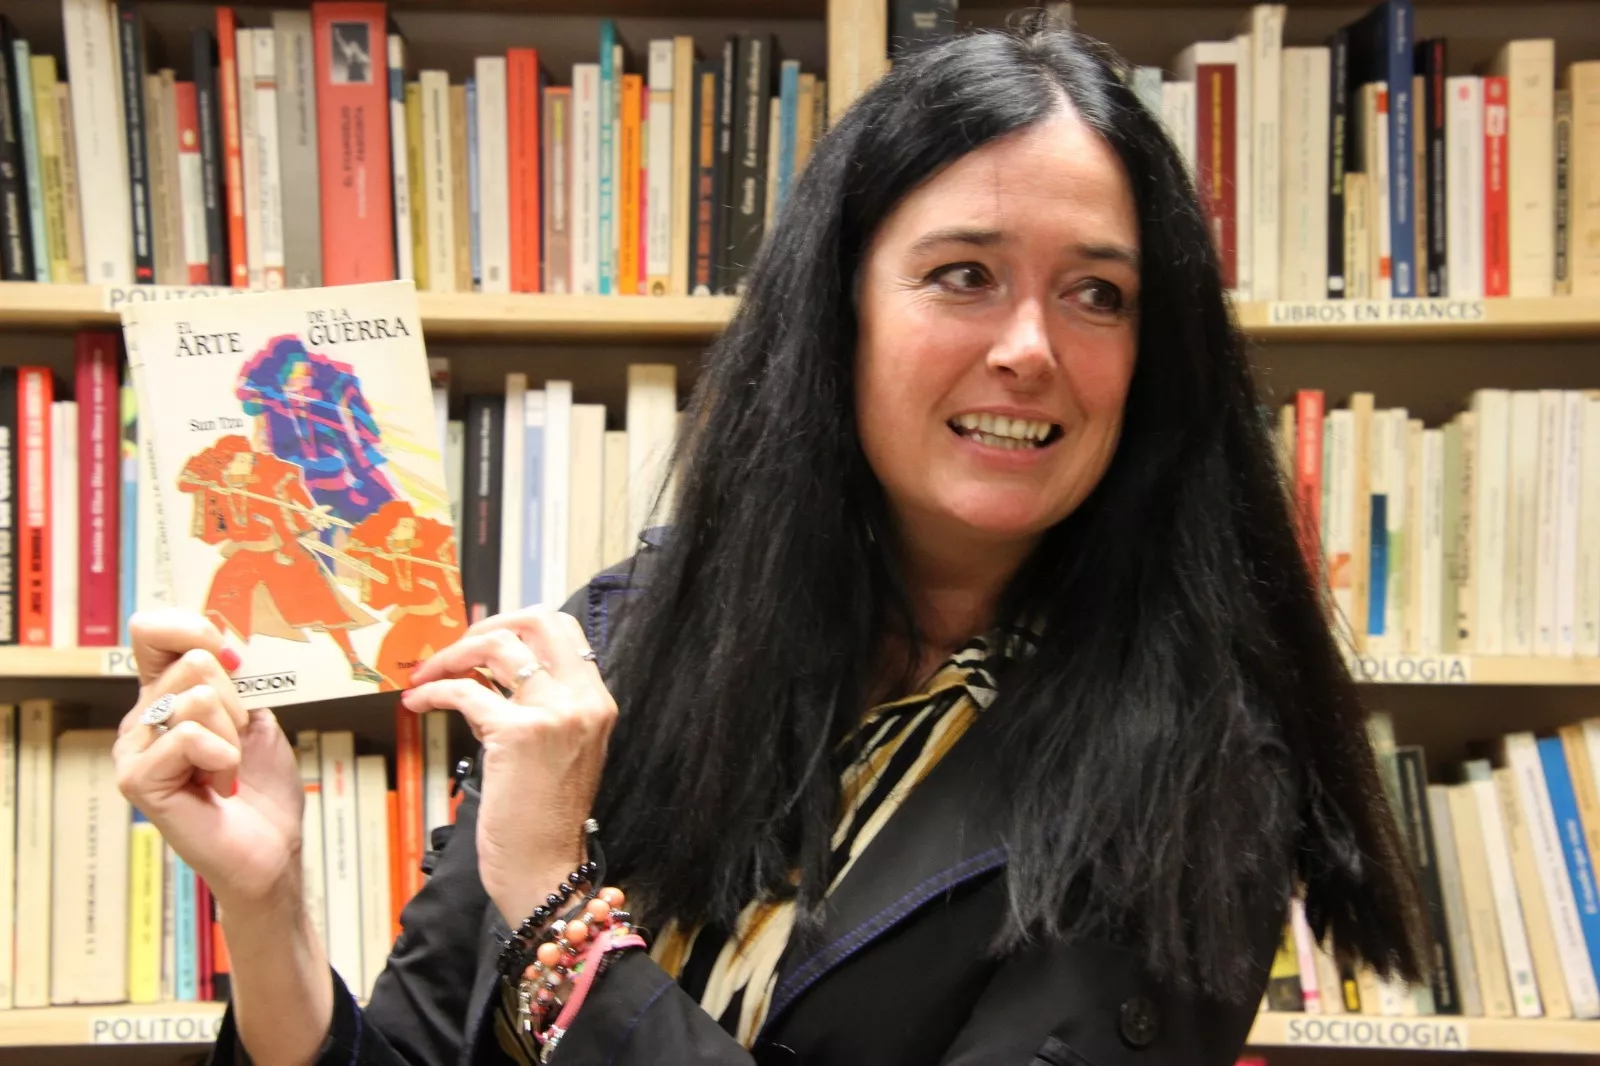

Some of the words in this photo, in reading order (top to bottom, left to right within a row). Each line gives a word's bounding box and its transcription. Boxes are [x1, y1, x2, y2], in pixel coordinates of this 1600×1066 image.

[305, 309, 326, 325] DE
[329, 308, 352, 322] LA
[1273, 304, 1347, 323] LIBROS
[1354, 303, 1381, 321] EN
[1388, 301, 1483, 320] FRANCES
[175, 321, 192, 335] EL
[307, 316, 411, 346] GUERRA
[176, 332, 244, 358] ARTE
[189, 419, 215, 432] Sun
[217, 416, 244, 430] Tzu
[232, 674, 297, 693] DICION
[1288, 1019, 1463, 1048] SOCIOLOGIA
